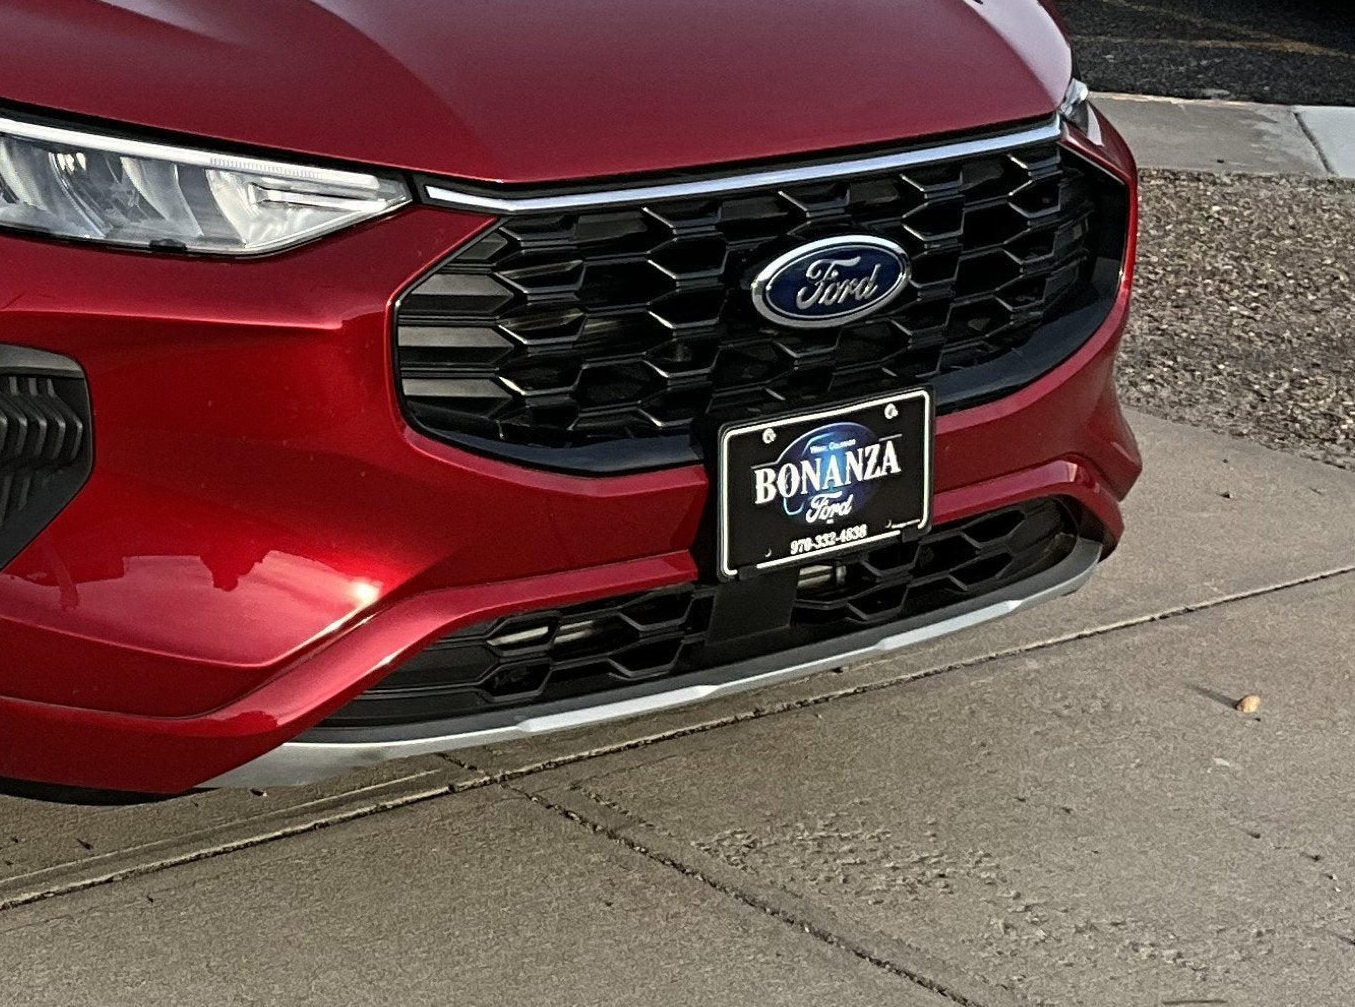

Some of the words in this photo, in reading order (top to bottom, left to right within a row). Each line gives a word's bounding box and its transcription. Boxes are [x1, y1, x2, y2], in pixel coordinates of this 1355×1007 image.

[796, 256, 881, 310] Ford
[754, 440, 902, 505] BONANZA
[805, 491, 854, 523] Ford
